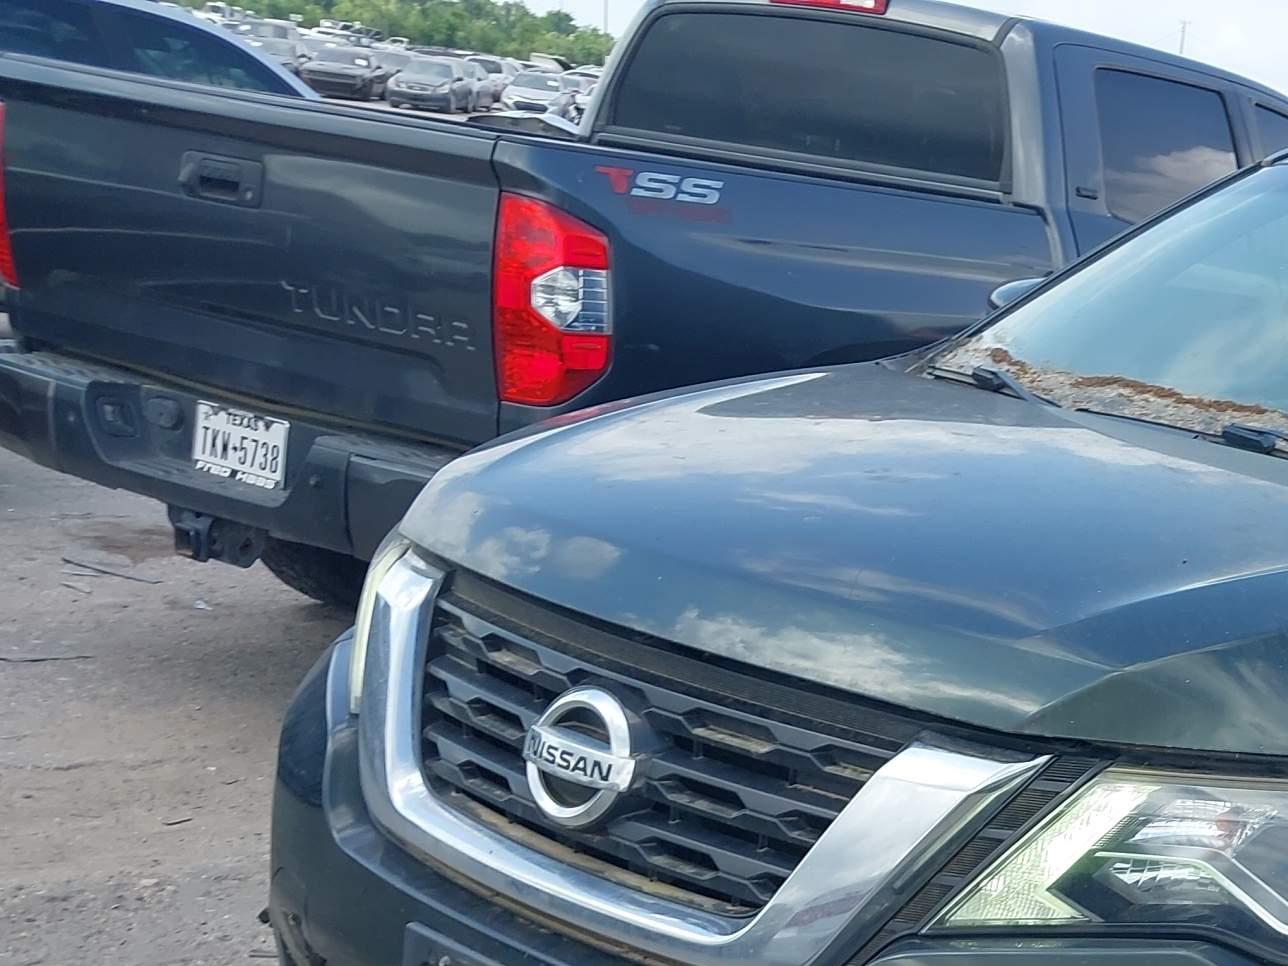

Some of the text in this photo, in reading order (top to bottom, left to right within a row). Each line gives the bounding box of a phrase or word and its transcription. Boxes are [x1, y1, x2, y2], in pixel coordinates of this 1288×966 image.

[594, 165, 725, 205] TSS
[280, 280, 476, 351] TUNDRA
[527, 734, 613, 783] NISSAN
